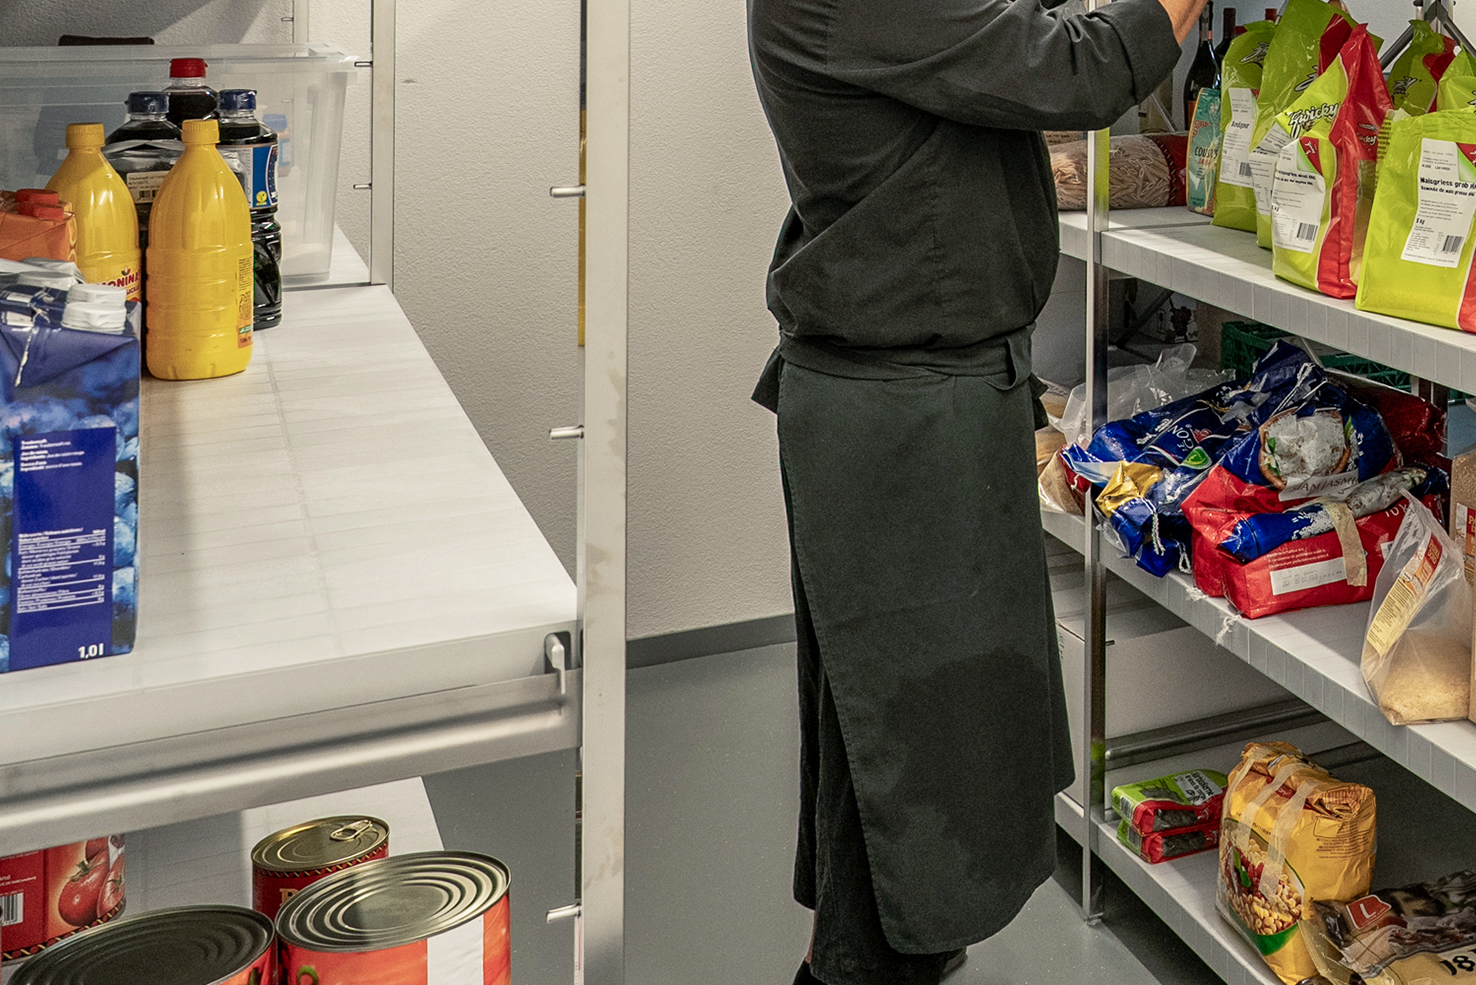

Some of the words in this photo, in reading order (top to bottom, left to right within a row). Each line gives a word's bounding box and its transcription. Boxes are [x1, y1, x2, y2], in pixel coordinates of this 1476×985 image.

[1285, 102, 1339, 132] Zwicky
[1420, 177, 1453, 186] Maisgriess
[1455, 181, 1469, 189] grob
[1439, 955, 1476, 976] 18
